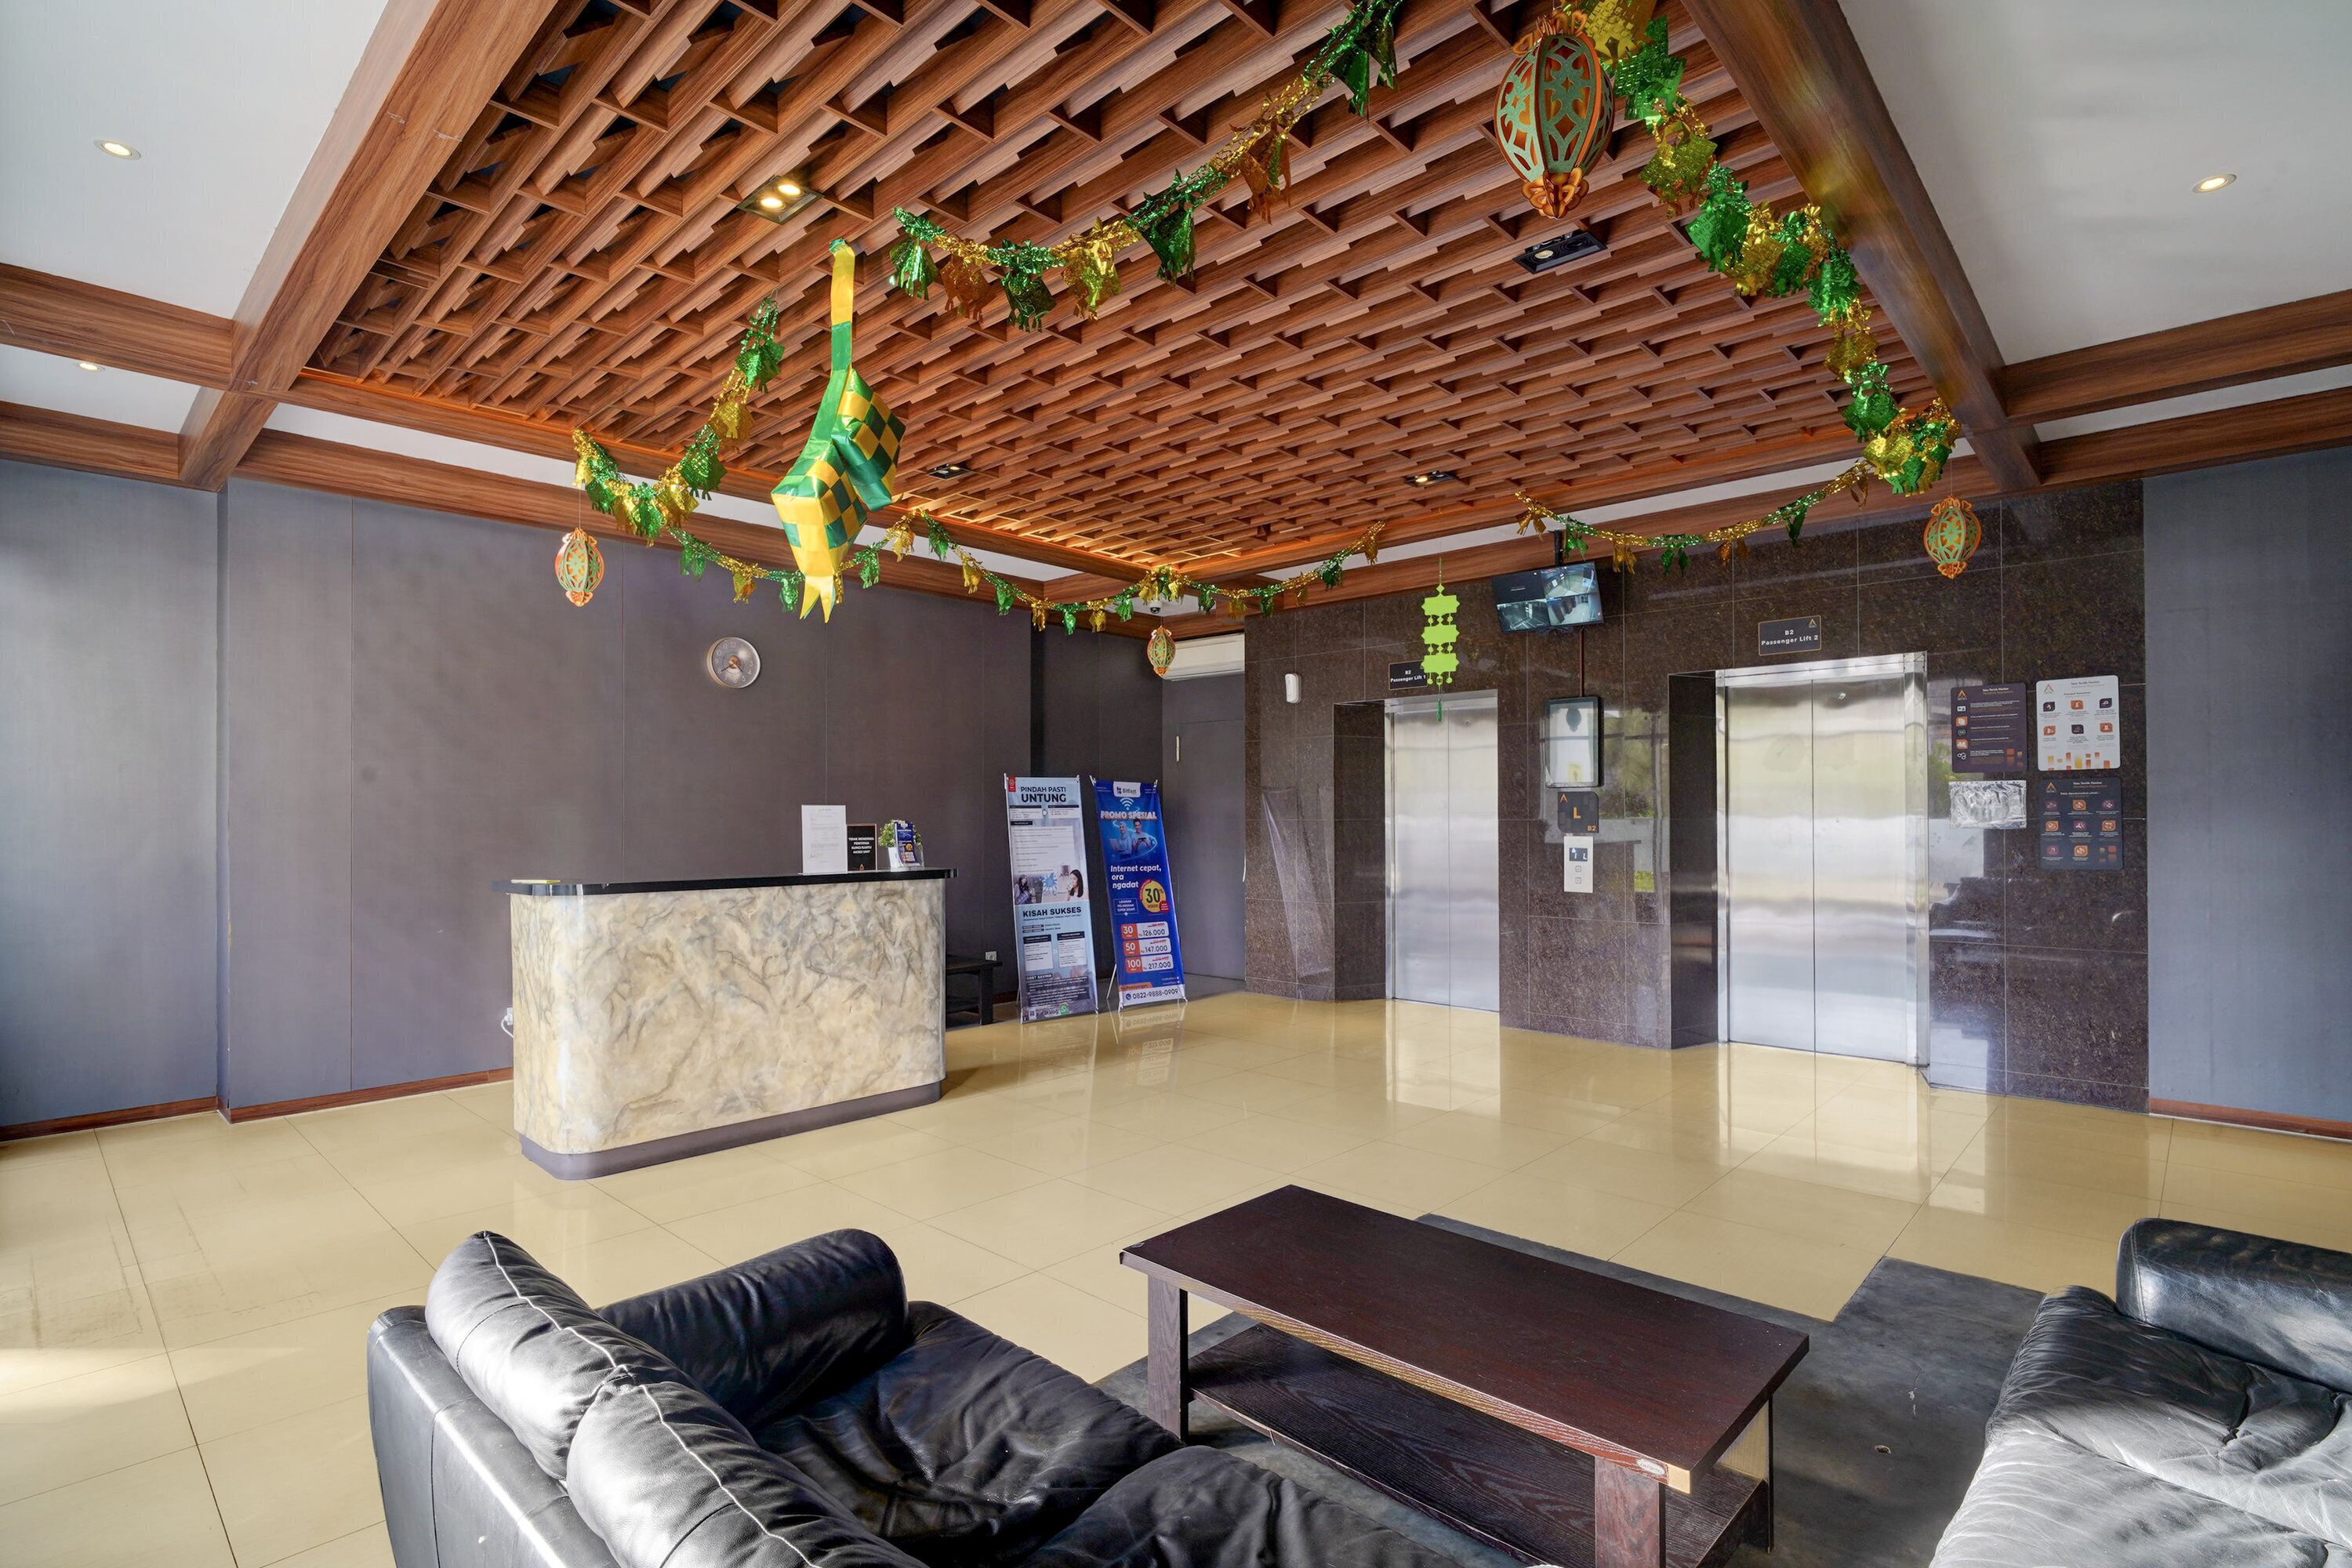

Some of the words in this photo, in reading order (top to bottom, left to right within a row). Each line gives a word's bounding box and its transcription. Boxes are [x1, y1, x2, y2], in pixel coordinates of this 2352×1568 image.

[1761, 637, 1798, 646] Passenger
[1021, 793, 1066, 803] UNTUNG
[1100, 810, 1127, 820] PROMO
[1128, 811, 1158, 820] SPESIAL
[1573, 807, 1581, 819] L
[1139, 864, 1162, 873] cepat,
[1112, 881, 1139, 890] ngadat
[1022, 909, 1048, 917] KISAH
[1050, 906, 1082, 915] SUKSES
[1123, 926, 1134, 935] 30
[1125, 942, 1136, 951] 50
[1127, 959, 1142, 968] 100
[1148, 961, 1171, 970] 217.000
[1132, 988, 1178, 1000] 0822-9888-0909
